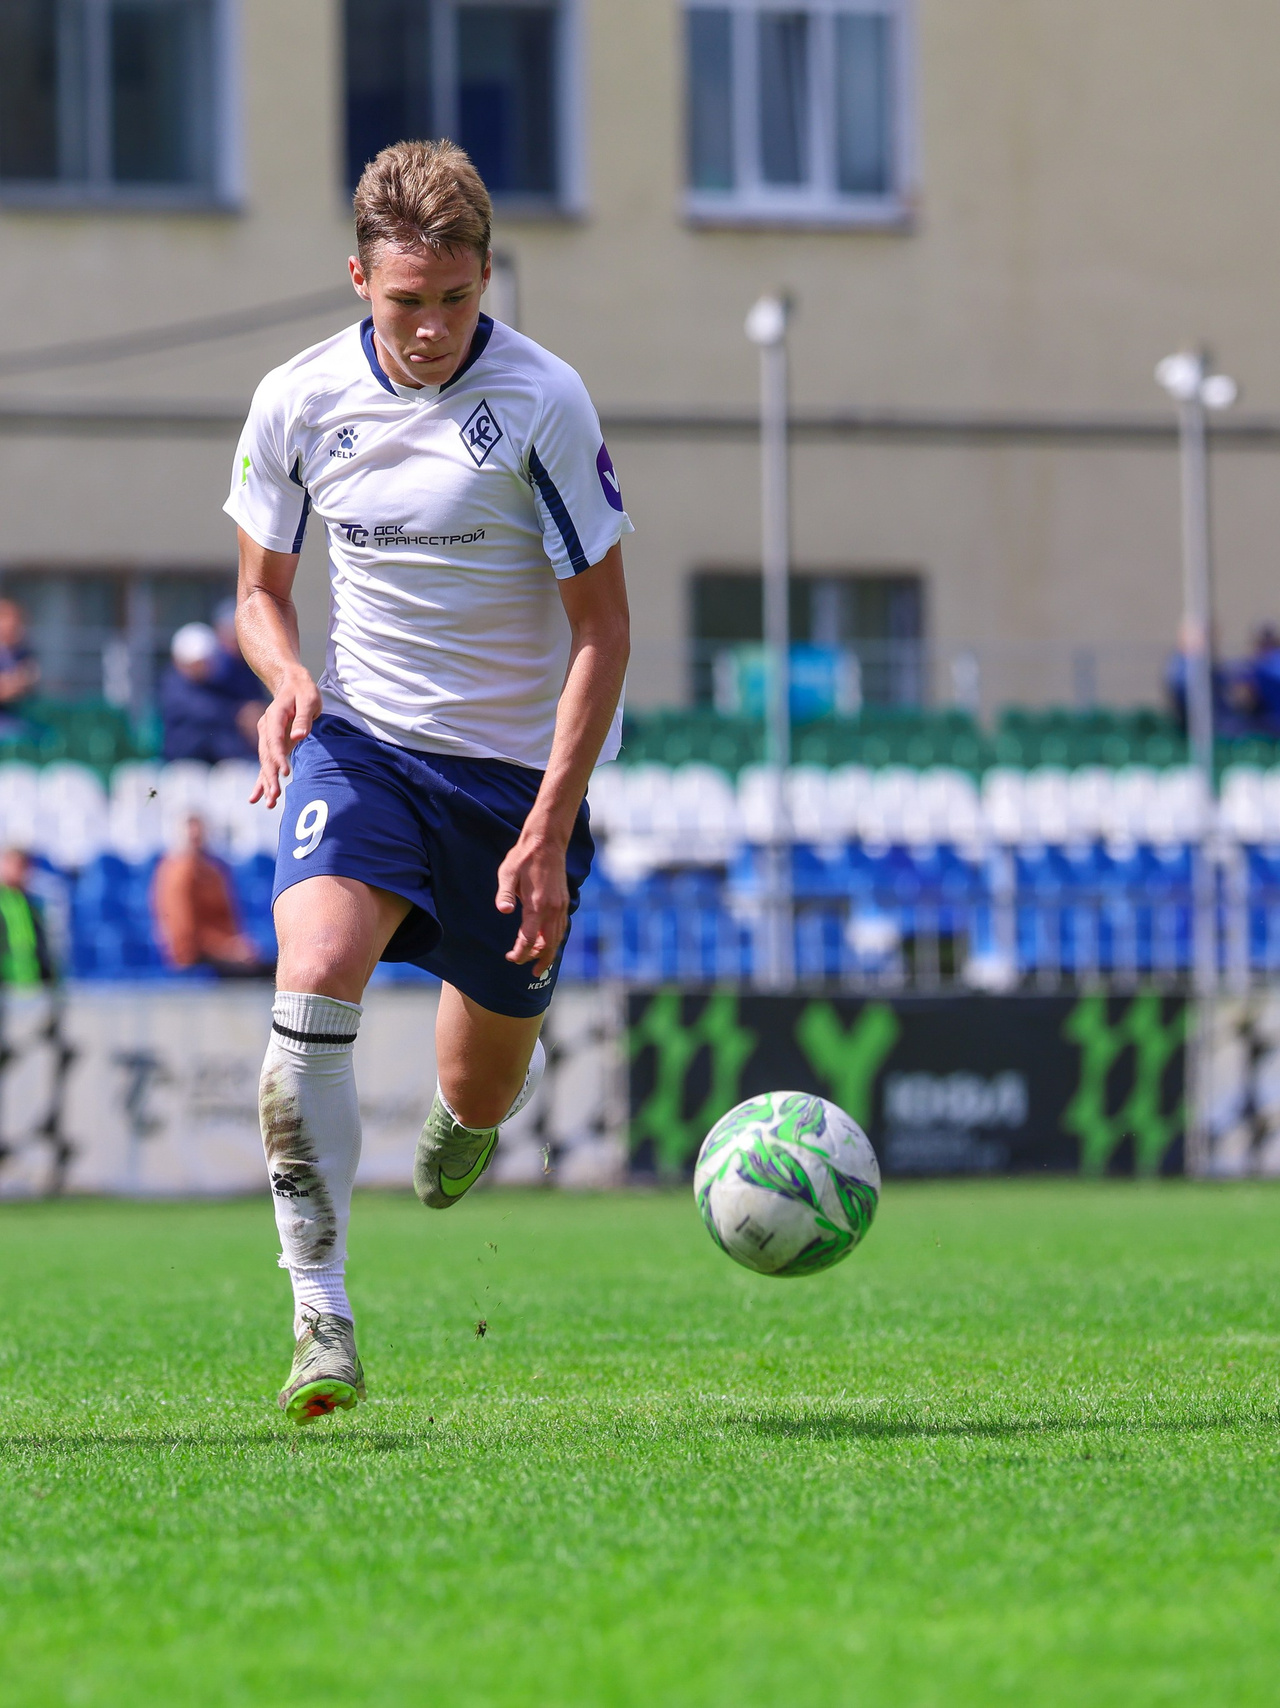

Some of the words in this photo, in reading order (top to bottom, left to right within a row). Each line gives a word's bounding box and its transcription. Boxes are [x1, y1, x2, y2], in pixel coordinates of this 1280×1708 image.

[329, 449, 357, 459] KELM
[374, 525, 404, 536] ДСК
[374, 528, 486, 547] ТРАНССТРОЙ
[292, 799, 329, 860] 9
